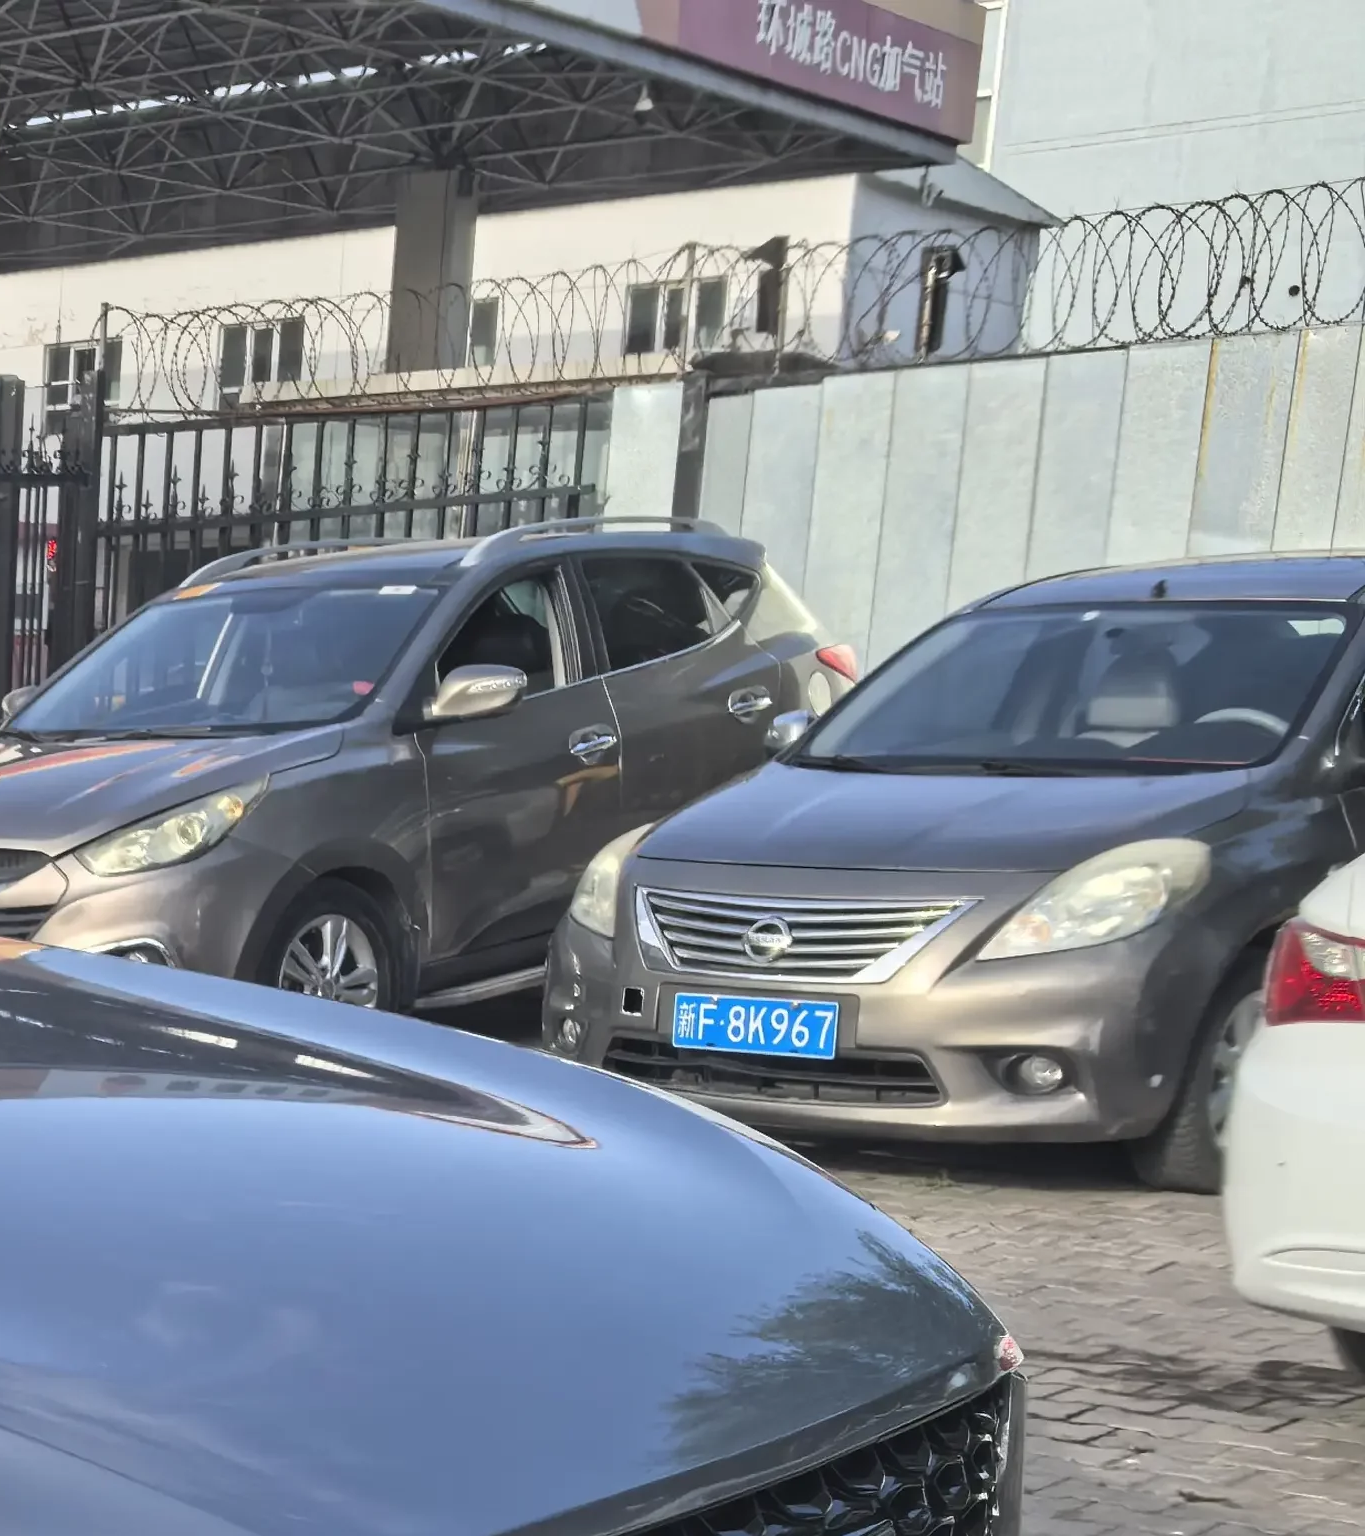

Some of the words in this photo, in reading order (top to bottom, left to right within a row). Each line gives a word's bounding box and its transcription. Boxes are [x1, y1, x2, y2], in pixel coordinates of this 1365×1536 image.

[756, 0, 946, 108] 环城路CNG加气站
[678, 1001, 834, 1049] 新F·8K967
